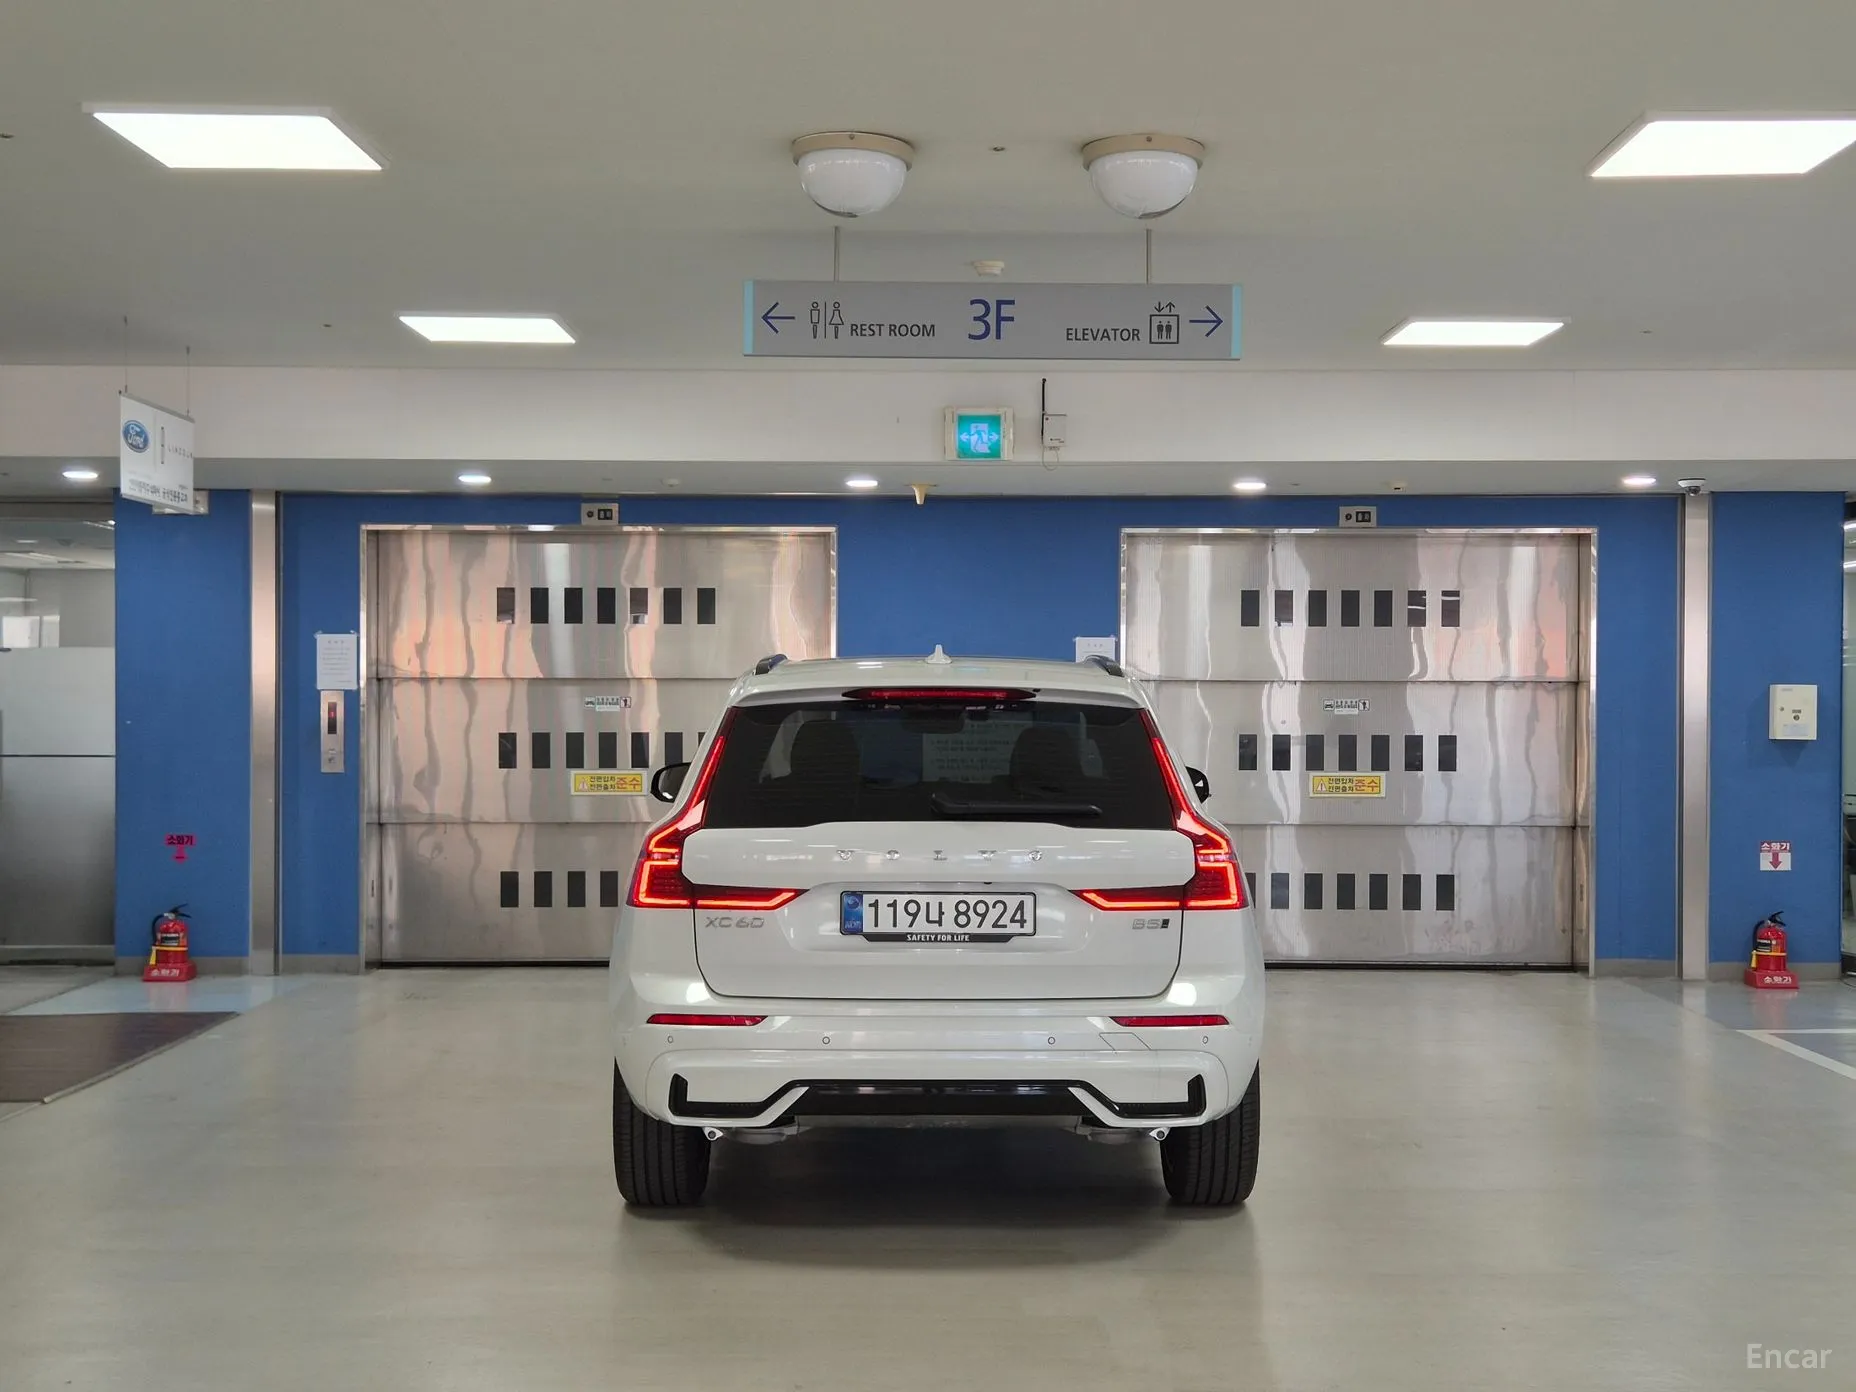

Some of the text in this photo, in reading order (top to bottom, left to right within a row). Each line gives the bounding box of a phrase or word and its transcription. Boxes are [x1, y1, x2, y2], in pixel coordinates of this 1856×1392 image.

[968, 298, 1015, 340] 3F
[850, 323, 936, 337] REST ROOM
[1065, 327, 1141, 342] ELEVATOR
[1354, 778, 1379, 792] 준수
[167, 834, 194, 846] 소화기
[1760, 842, 1791, 851] 소화기
[868, 898, 1028, 929] 119나 8924
[906, 933, 970, 942] SAFETY FOR LIFE
[150, 967, 180, 977] 소화기
[1763, 975, 1793, 985] 소화기
